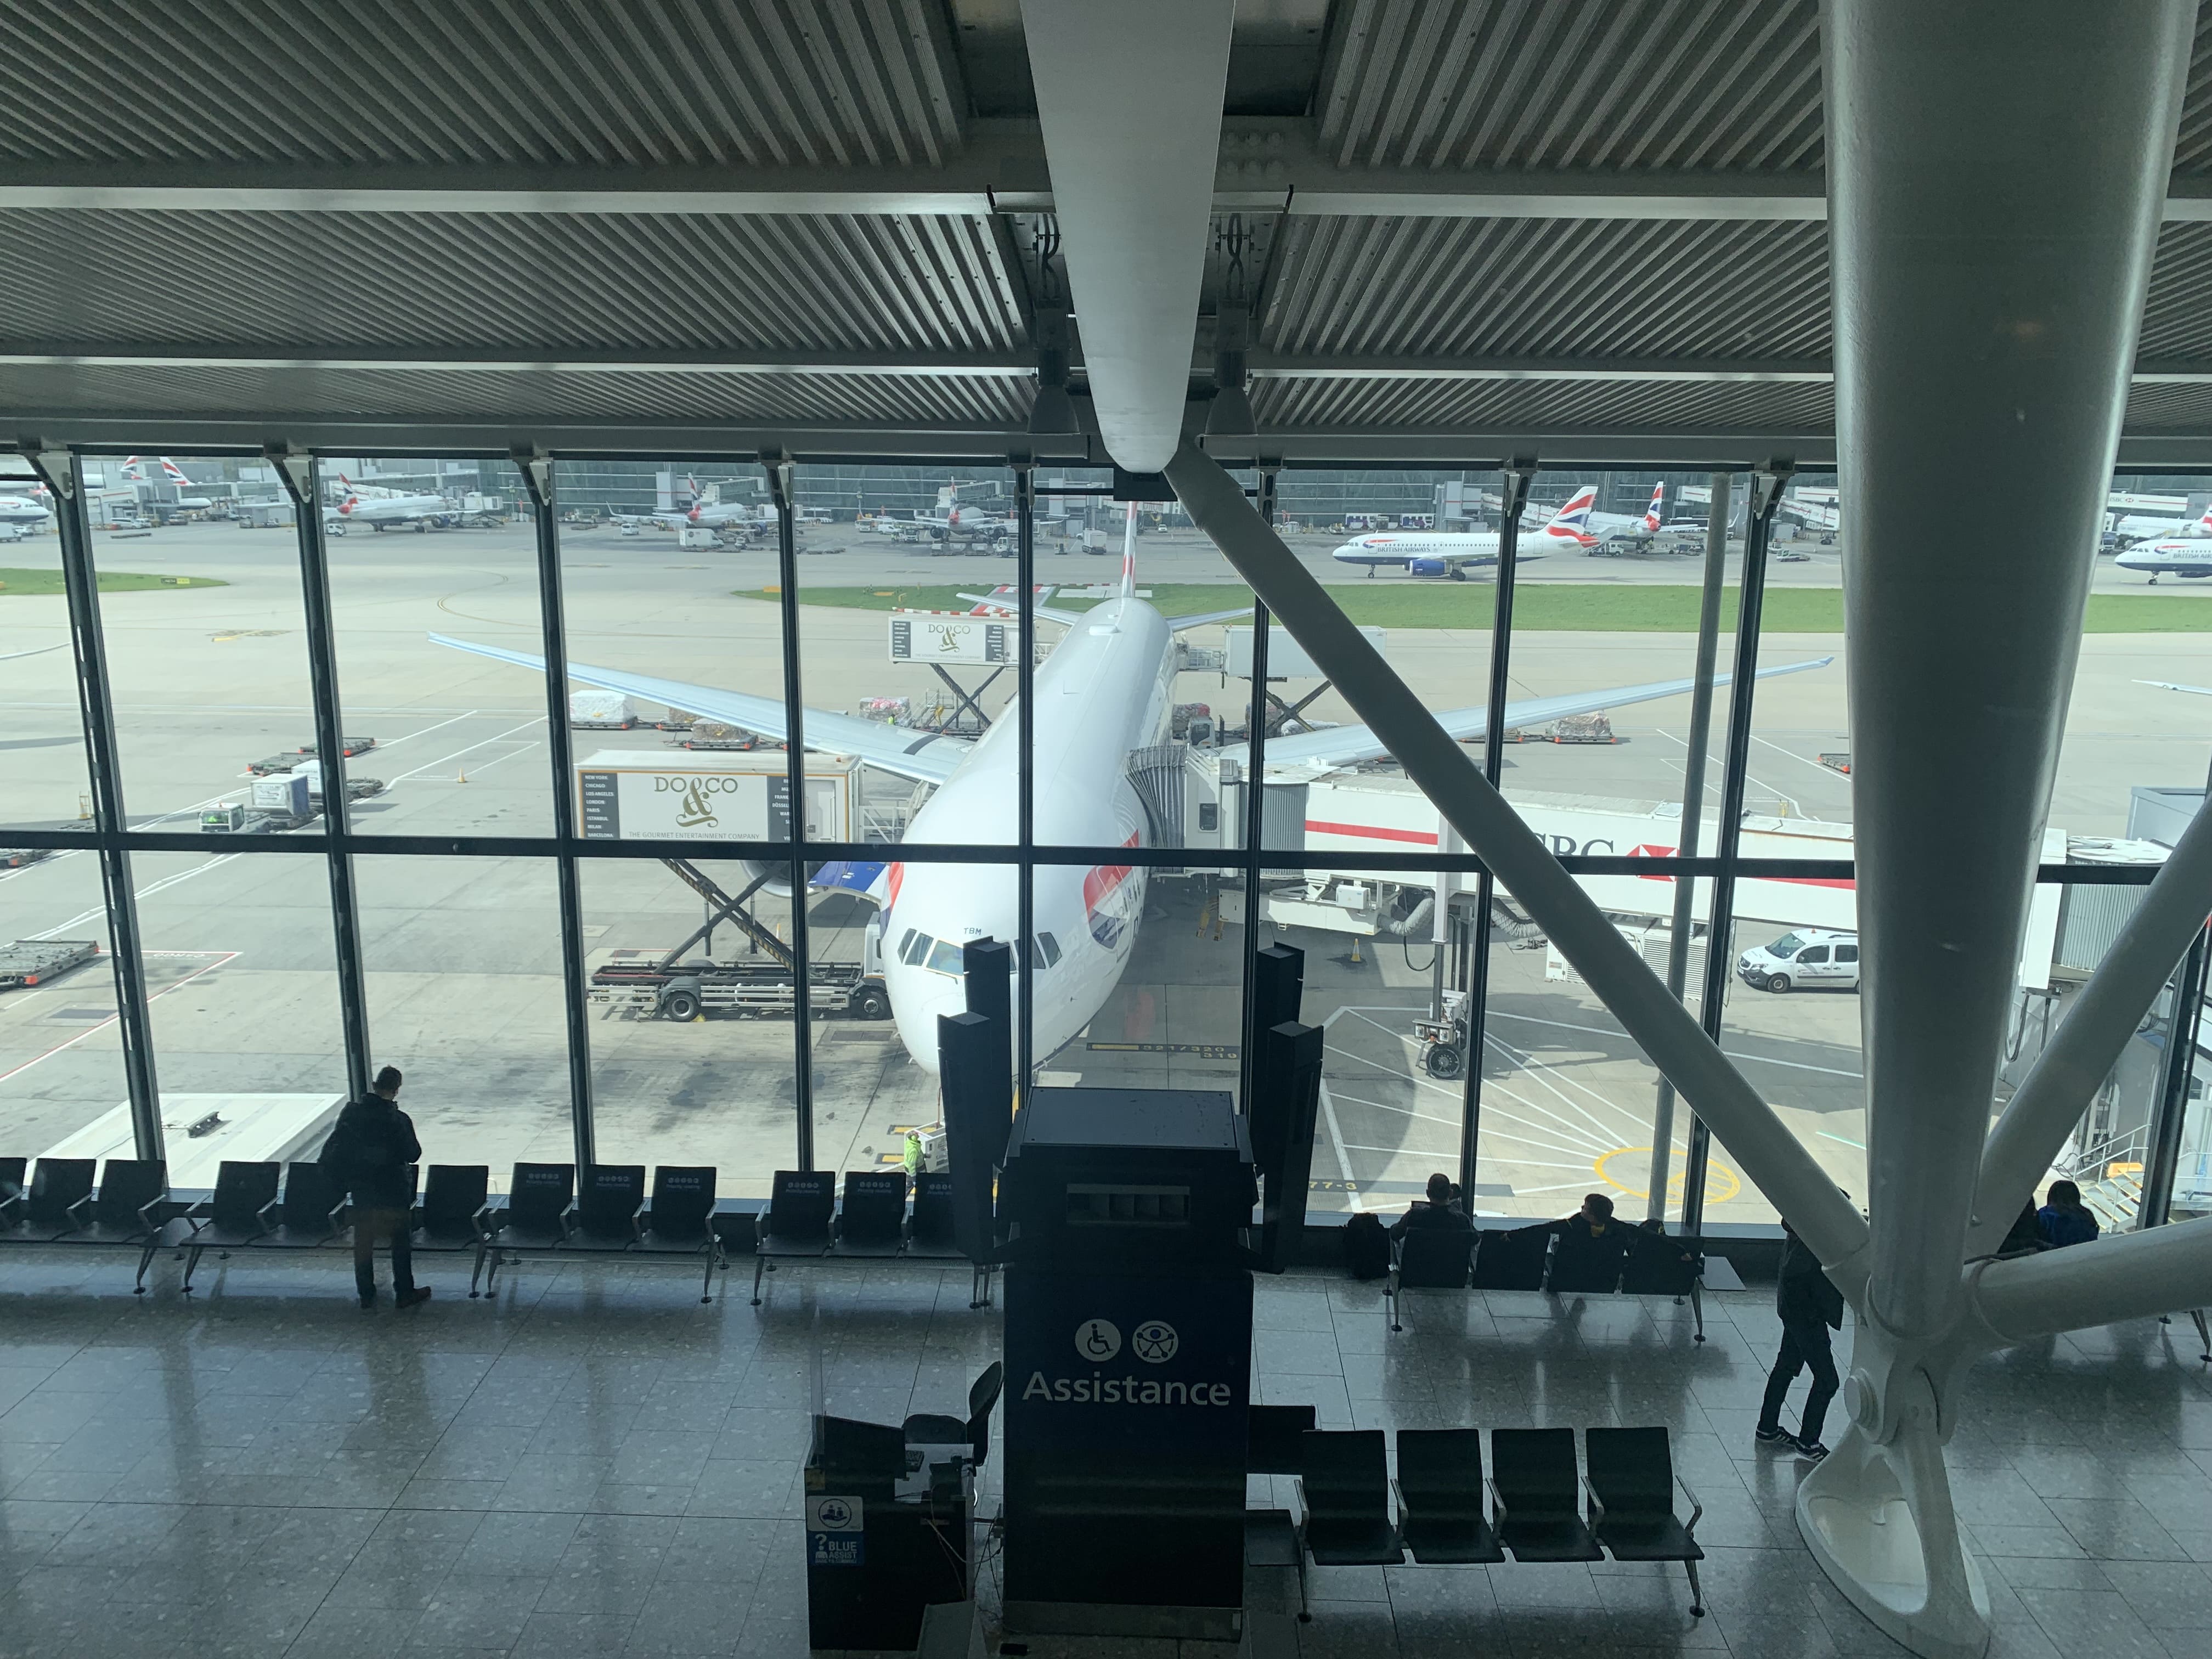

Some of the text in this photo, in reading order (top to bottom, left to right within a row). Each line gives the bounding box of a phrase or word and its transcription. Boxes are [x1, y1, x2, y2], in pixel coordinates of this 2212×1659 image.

[964, 927, 981, 935] TBM
[1022, 1371, 1231, 1406] Assistance
[828, 1541, 857, 1551] BLUE
